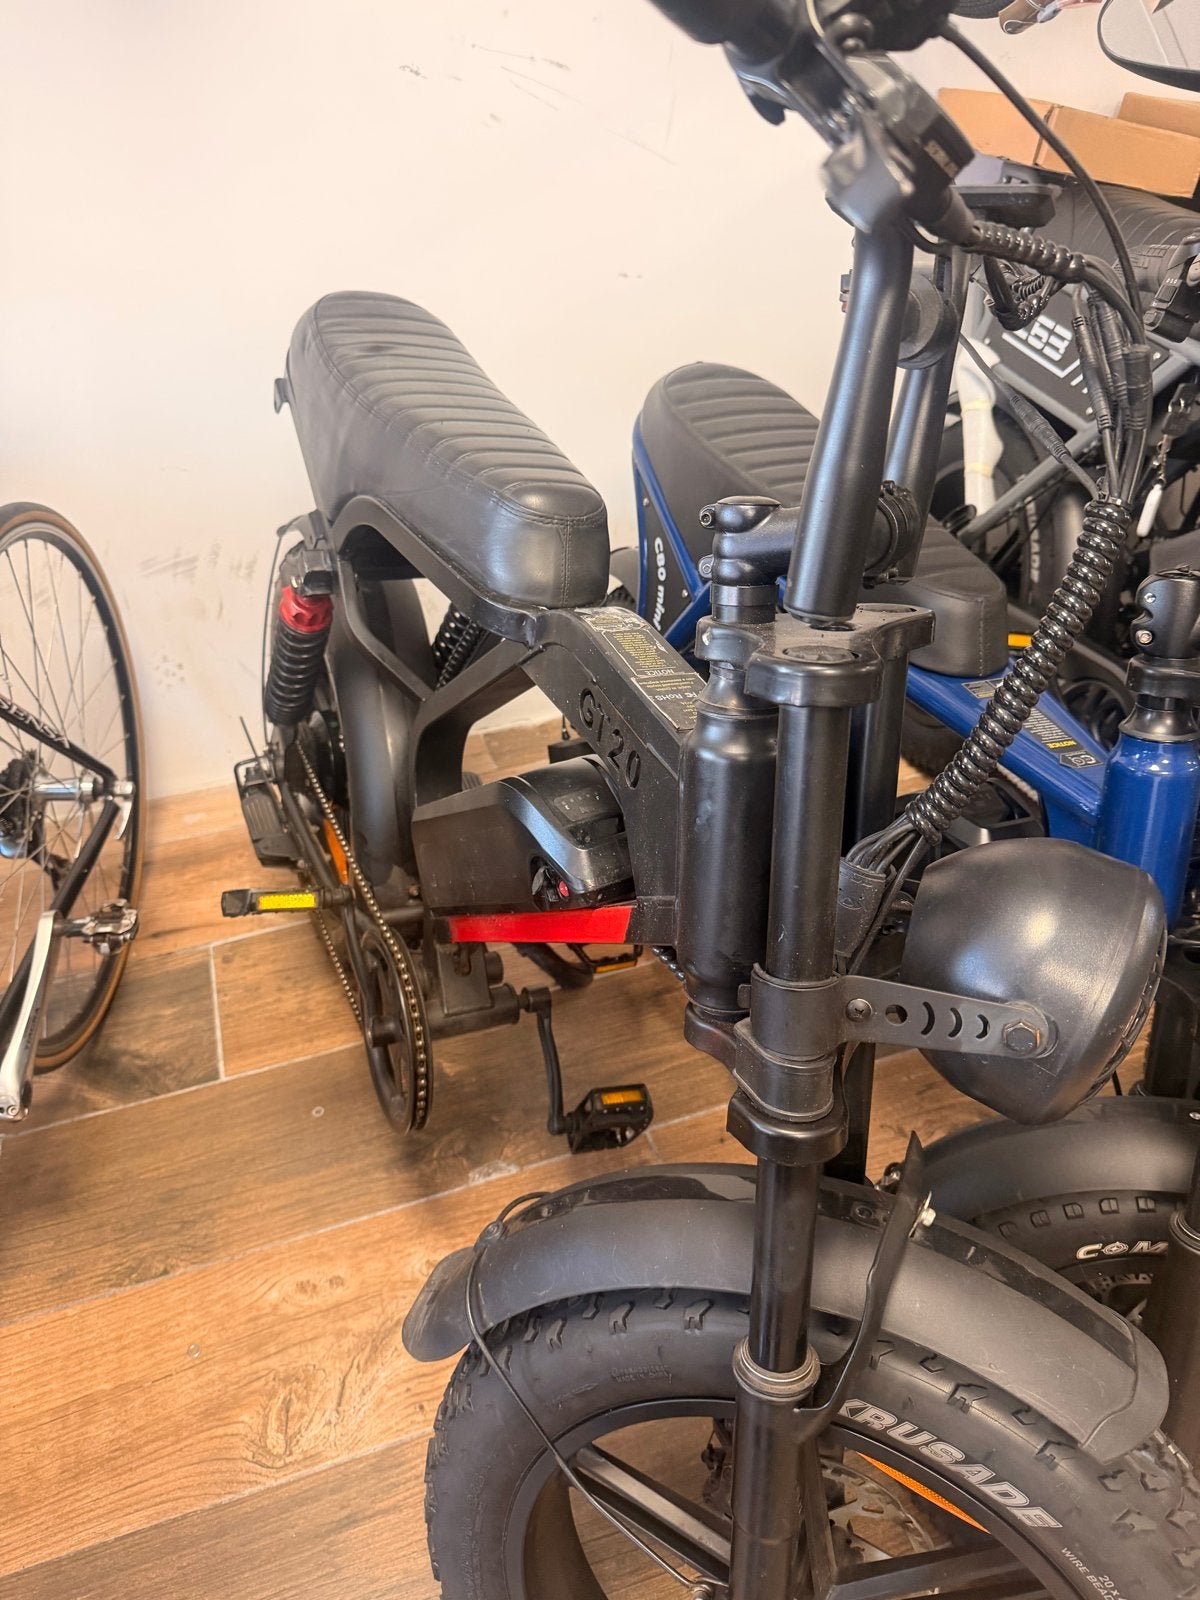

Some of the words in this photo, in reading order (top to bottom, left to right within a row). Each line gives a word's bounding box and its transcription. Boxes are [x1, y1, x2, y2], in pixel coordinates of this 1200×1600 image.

[653, 585, 666, 632] mini
[580, 688, 641, 789] GT20
[1061, 1547, 1090, 1578] WIRE
[1098, 1575, 1114, 1589] 20
